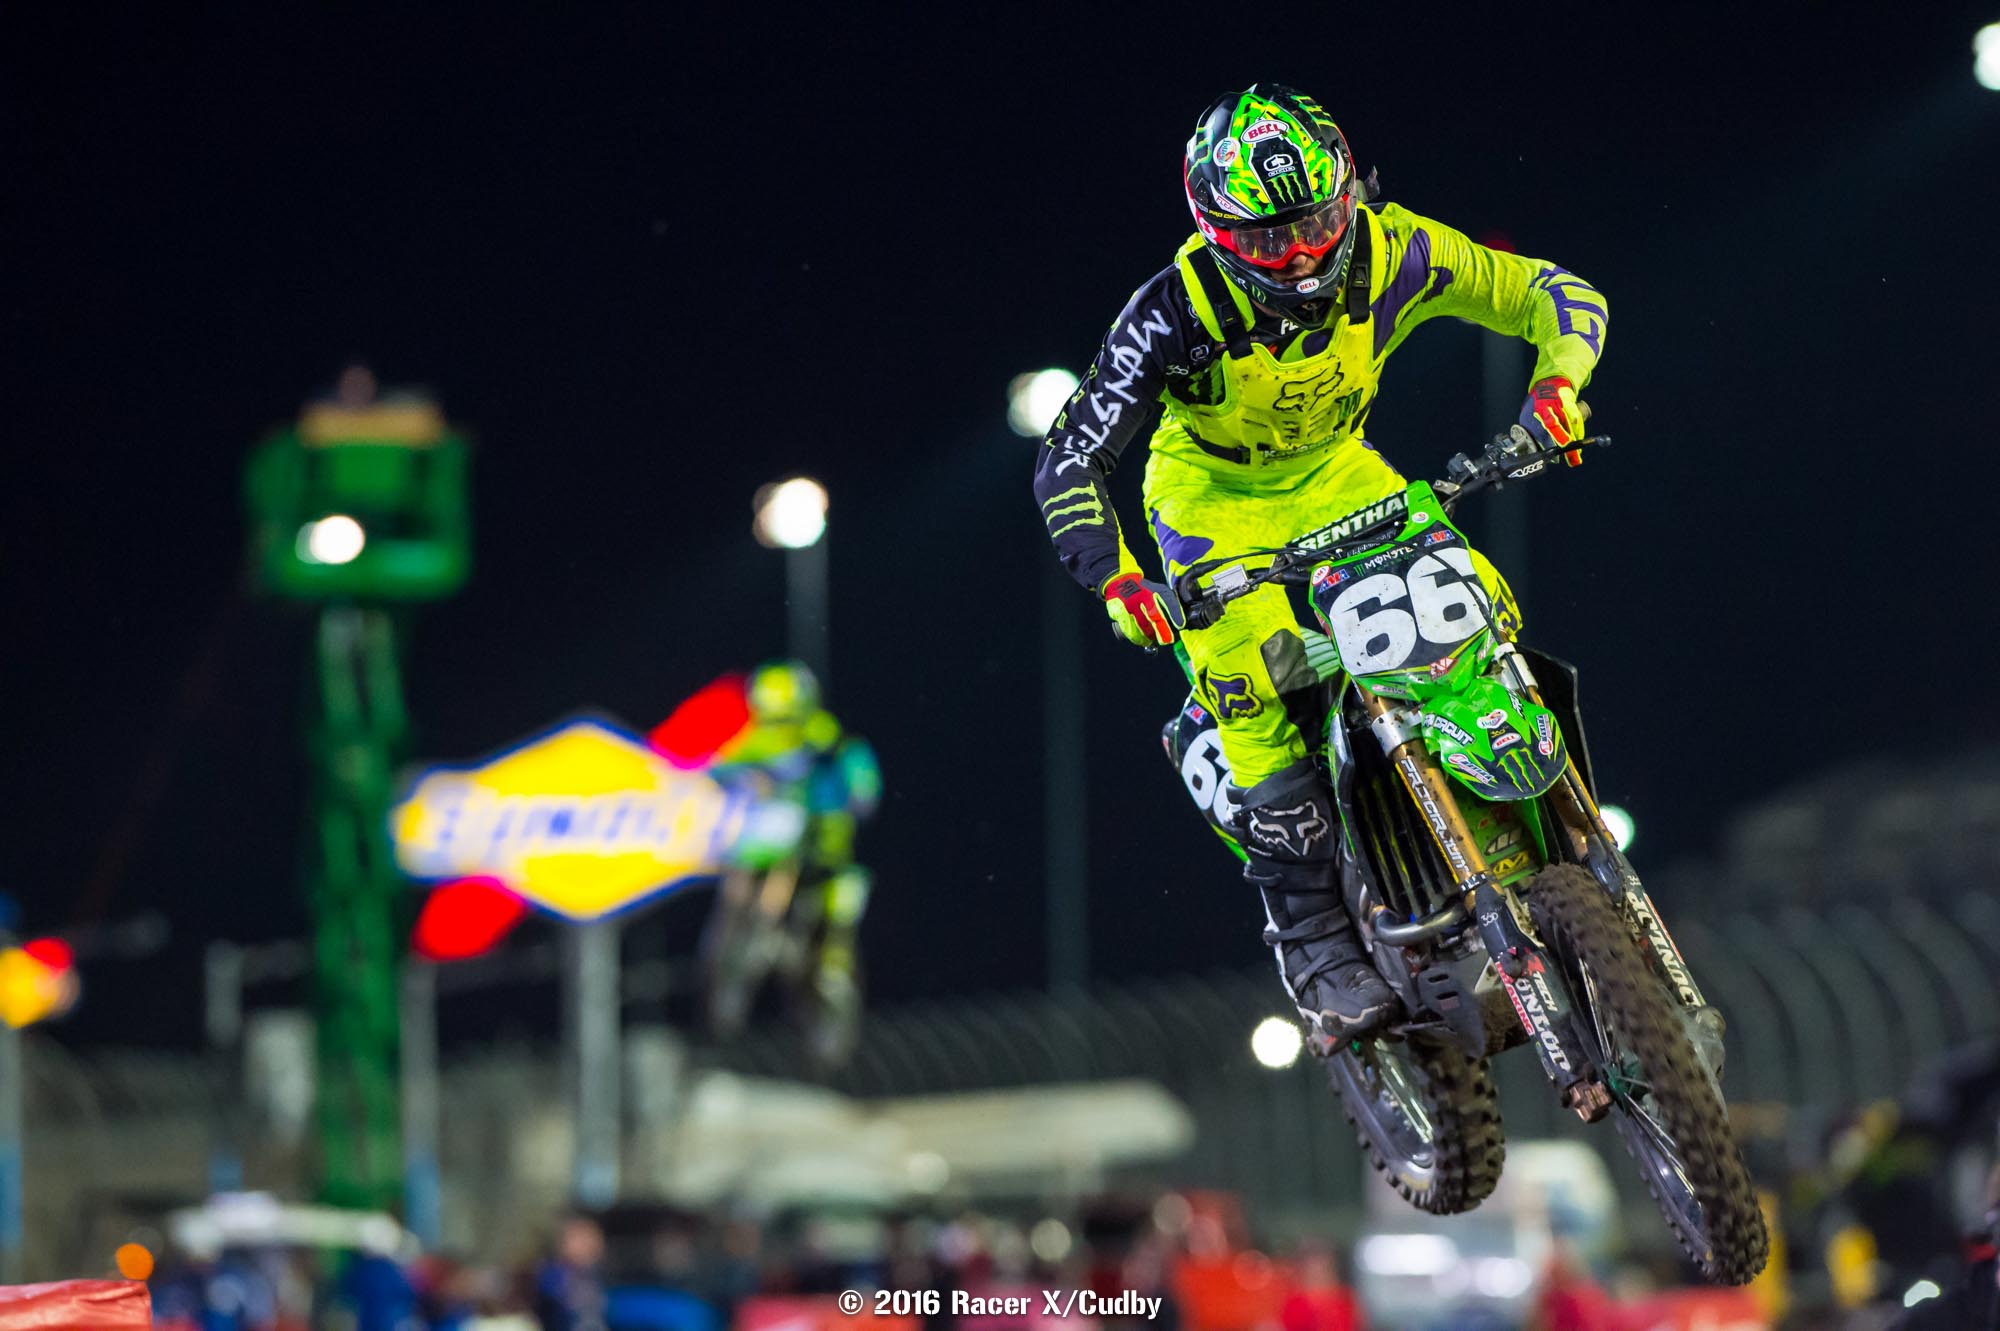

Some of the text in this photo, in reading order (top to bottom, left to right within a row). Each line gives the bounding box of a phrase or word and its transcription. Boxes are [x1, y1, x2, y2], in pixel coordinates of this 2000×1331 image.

[1248, 124, 1281, 140] BELL
[1300, 281, 1316, 291] BELL
[1424, 530, 1456, 547] AMA
[1319, 569, 1350, 593] AMA
[1329, 547, 1490, 676] 66
[1401, 756, 1430, 800] PRO
